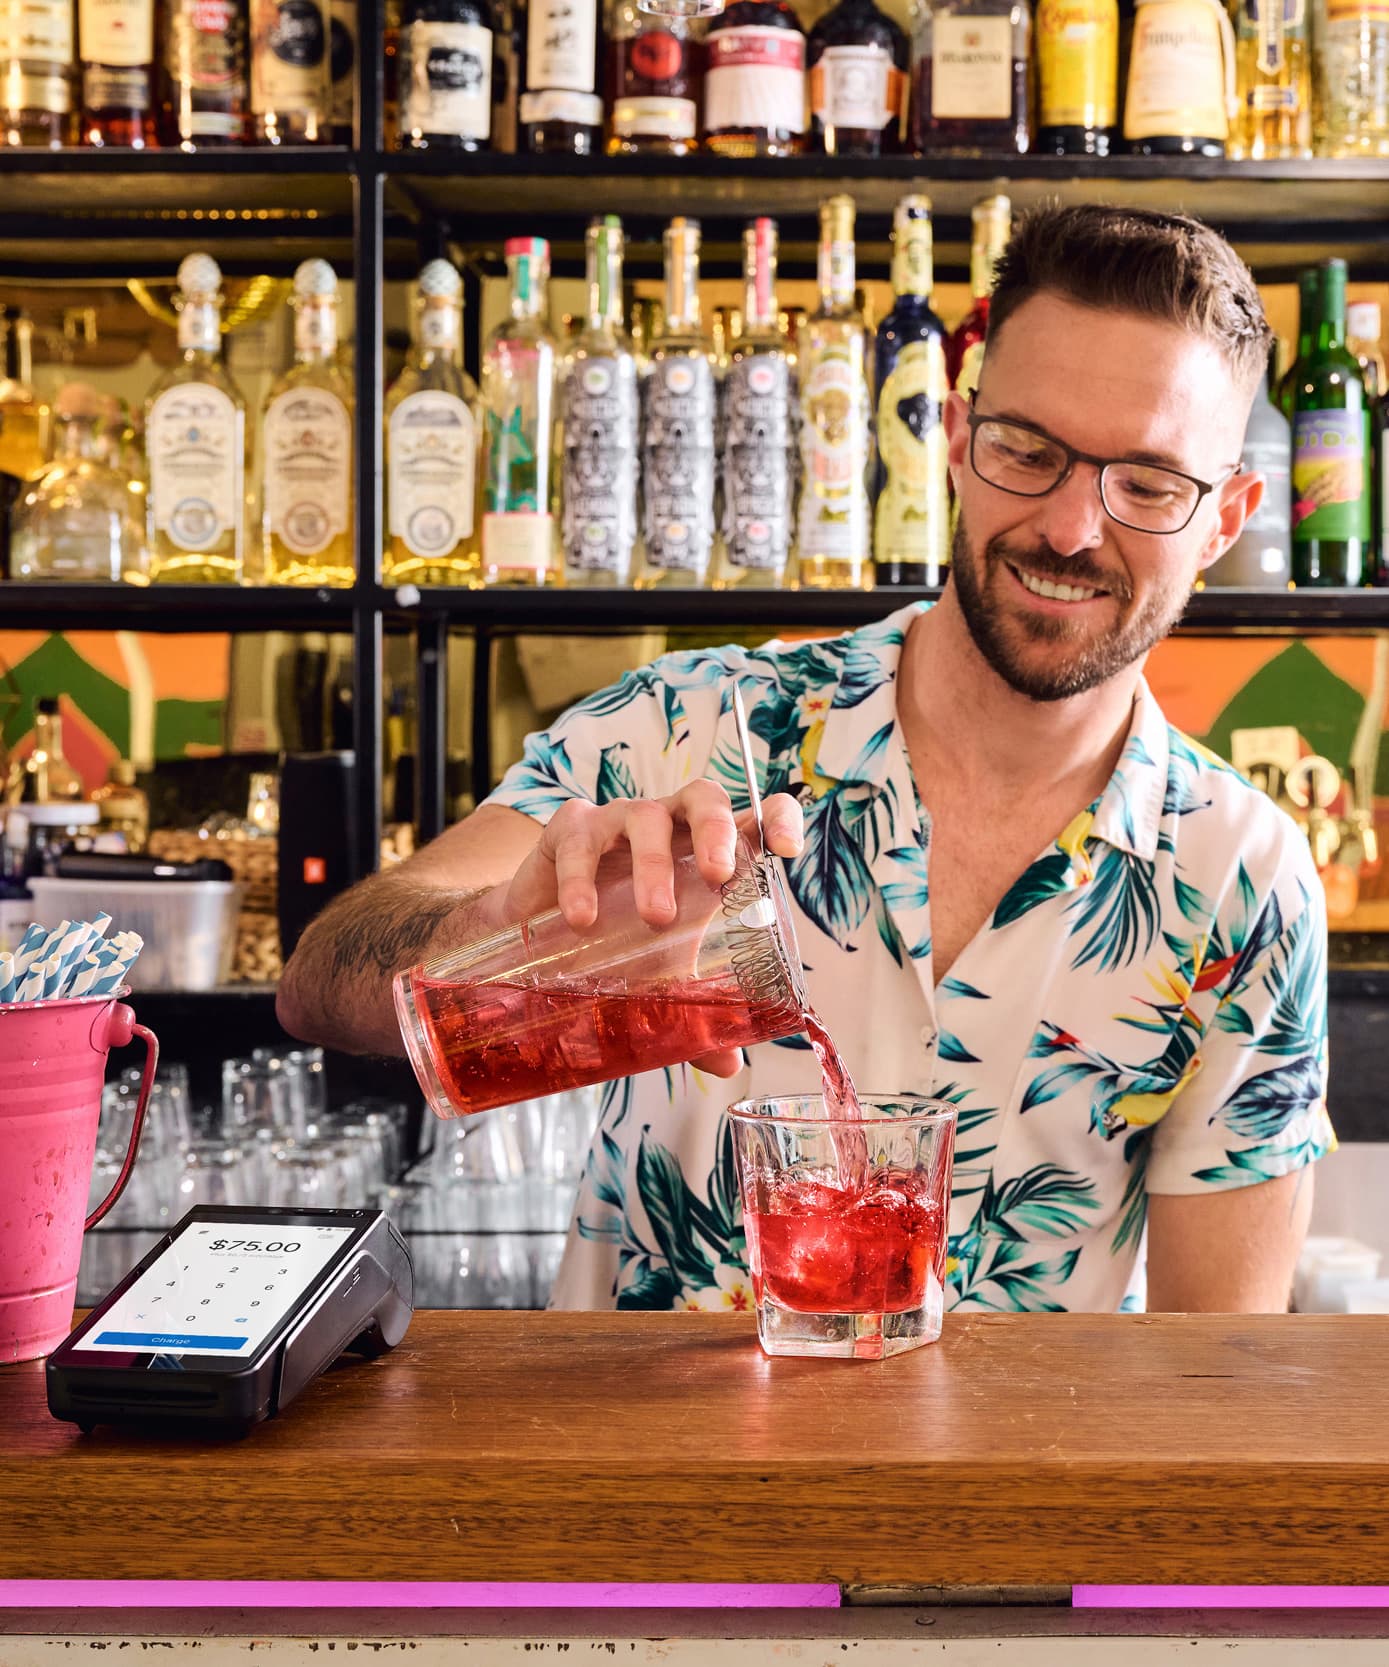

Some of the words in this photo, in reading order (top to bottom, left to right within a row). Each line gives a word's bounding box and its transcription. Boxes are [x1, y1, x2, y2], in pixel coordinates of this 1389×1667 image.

[208, 1238, 302, 1253] $75.00
[228, 1266, 240, 1274] 2
[151, 1336, 191, 1345] Charge
